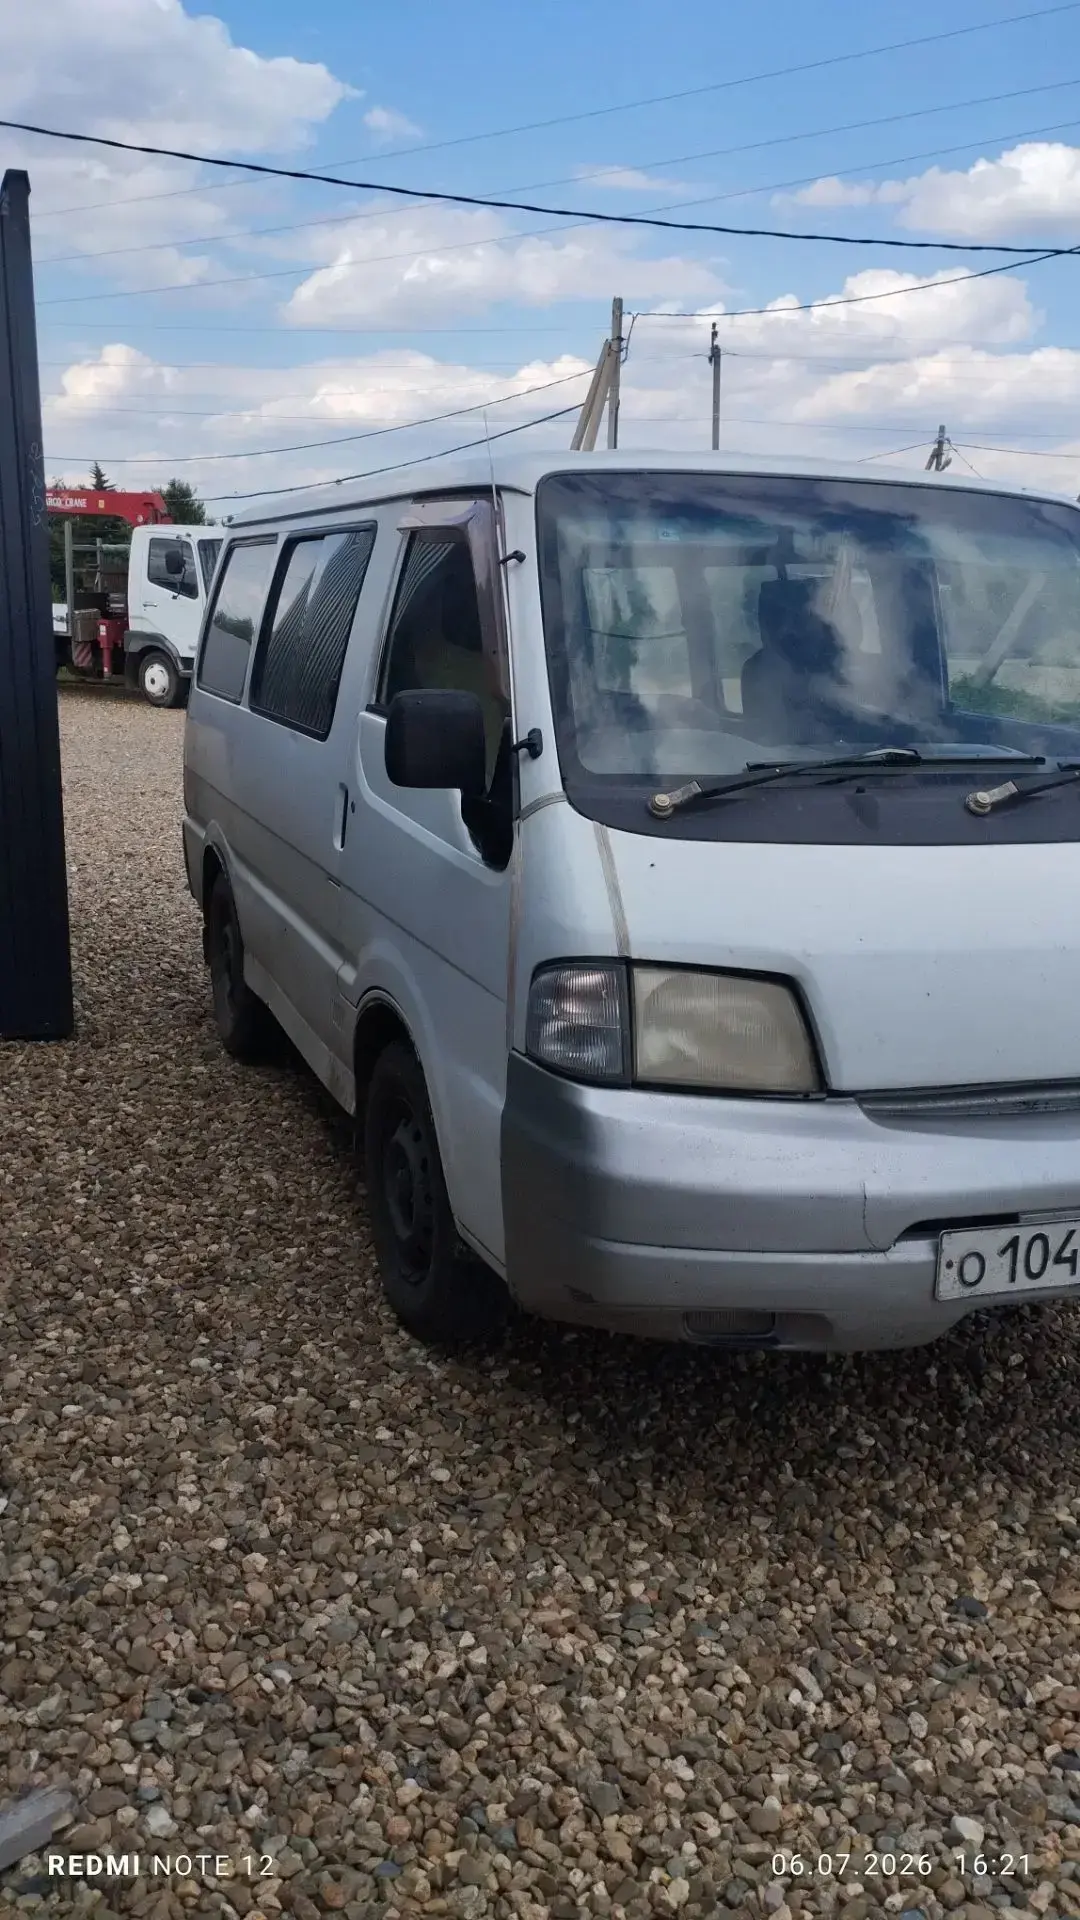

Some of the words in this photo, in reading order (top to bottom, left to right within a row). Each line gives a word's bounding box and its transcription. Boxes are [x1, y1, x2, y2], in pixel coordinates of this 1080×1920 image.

[45, 497, 62, 507] ARGO
[65, 498, 88, 508] CRANE
[997, 1229, 1078, 1284] 104
